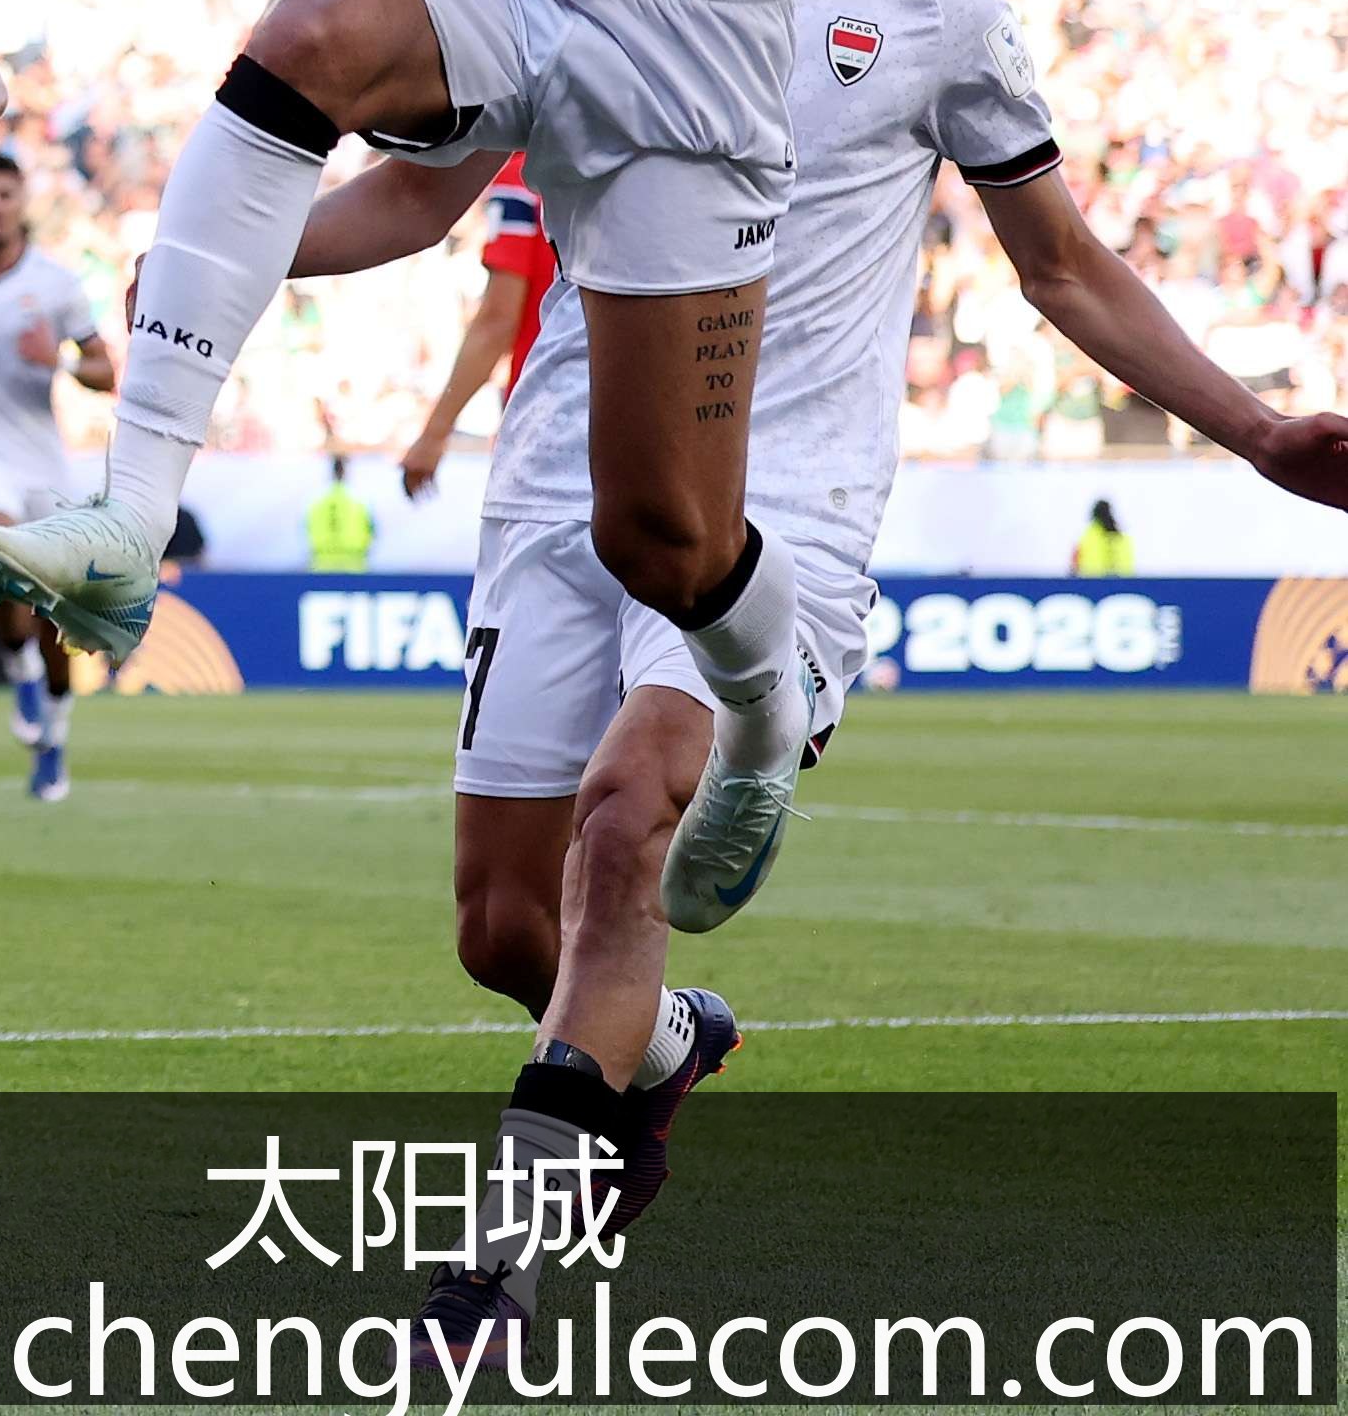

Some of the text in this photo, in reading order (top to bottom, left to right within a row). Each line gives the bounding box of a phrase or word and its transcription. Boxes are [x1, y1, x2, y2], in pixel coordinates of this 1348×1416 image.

[841, 21, 873, 34] IRAQ
[734, 217, 776, 250] JAKO
[696, 309, 755, 333] GAME
[134, 314, 214, 358] JAKO
[696, 339, 750, 363] PLAY
[705, 372, 735, 391] TO
[696, 401, 735, 423] WIN
[299, 591, 465, 672] FIFA
[905, 592, 1159, 674] 2026
[462, 627, 500, 751] 7
